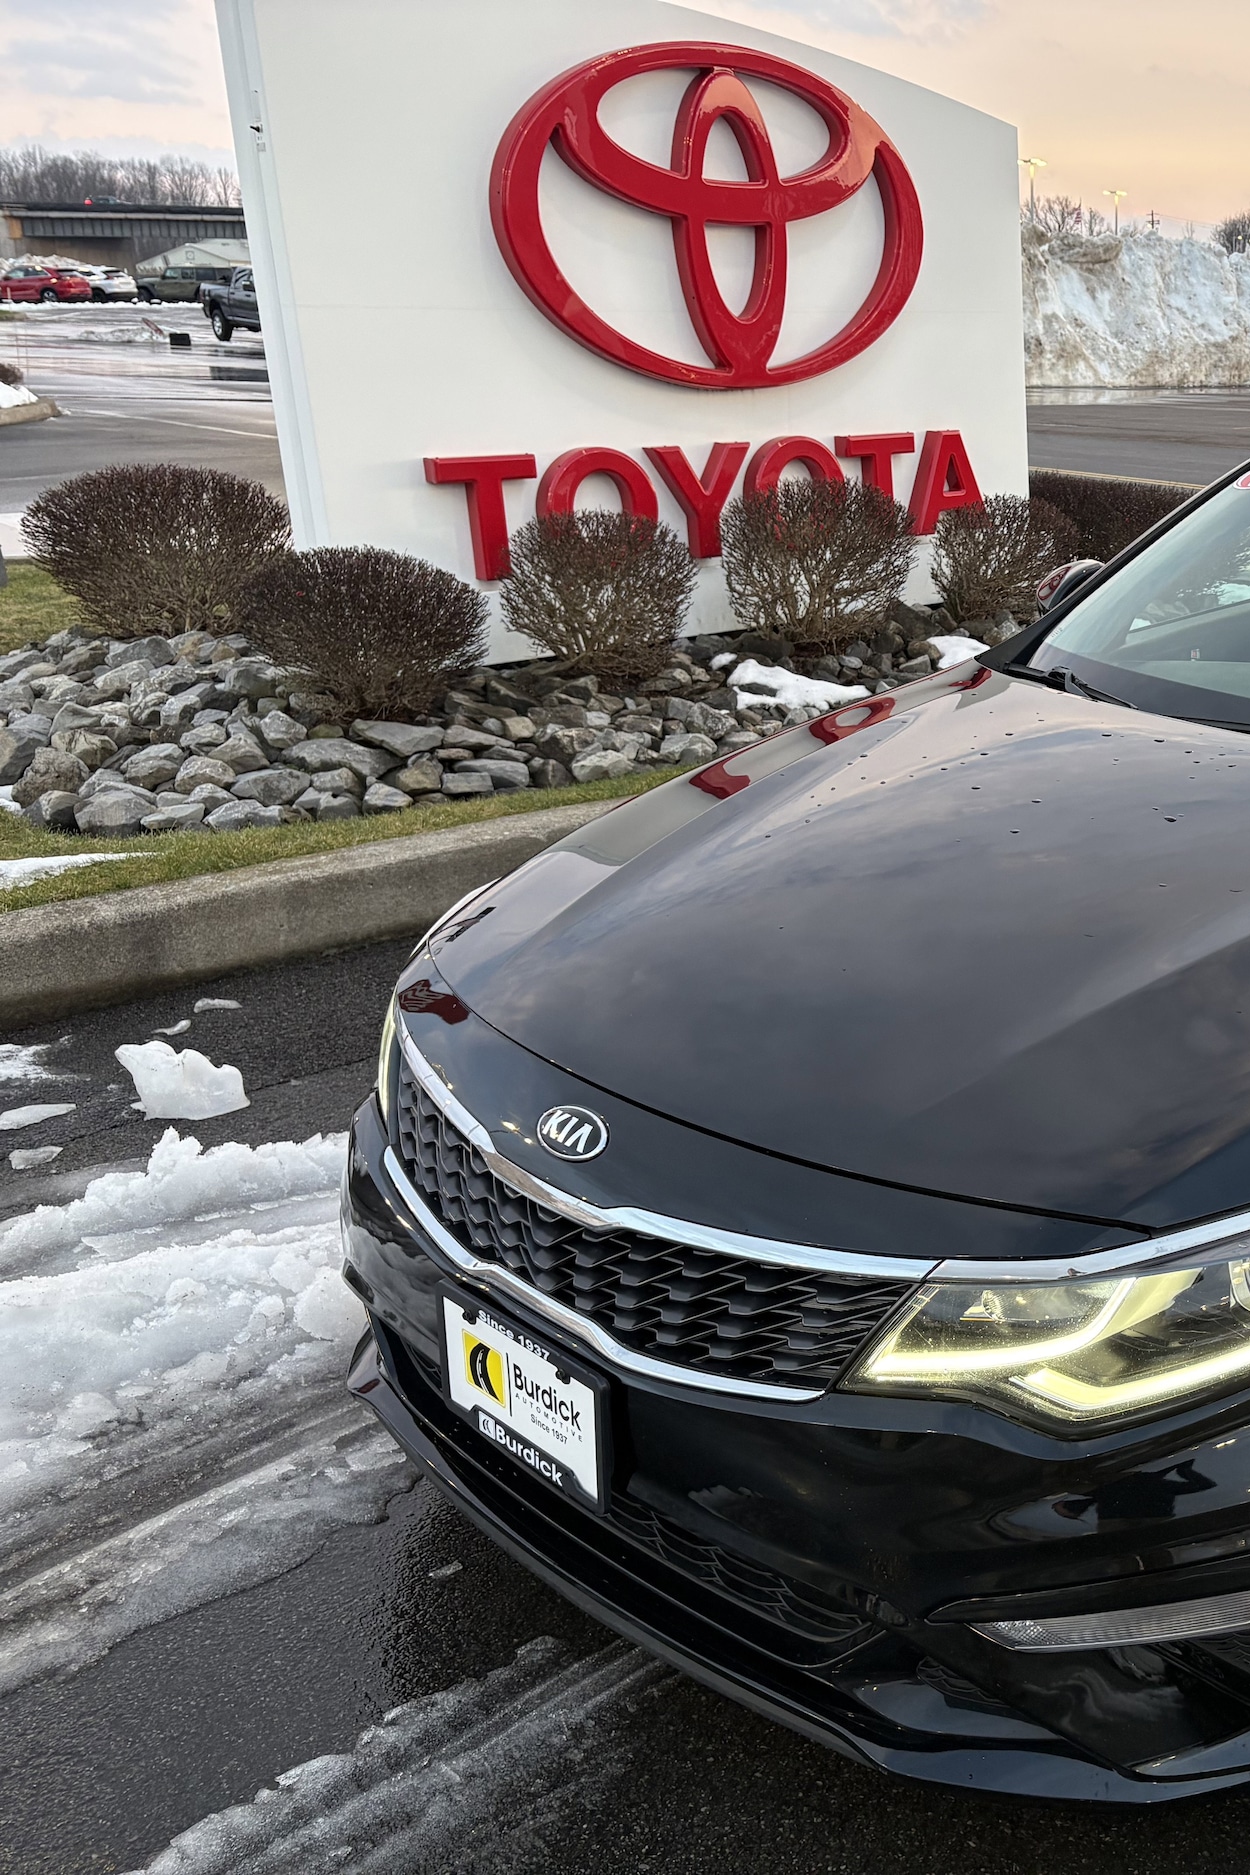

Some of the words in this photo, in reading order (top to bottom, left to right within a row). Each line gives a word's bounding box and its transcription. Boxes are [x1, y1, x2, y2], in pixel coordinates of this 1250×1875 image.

[423, 430, 987, 580] TOYOTA
[542, 1110, 594, 1154] KIA
[478, 1309, 514, 1341] Since
[517, 1334, 550, 1361] 1937
[513, 1362, 582, 1431] Burdick
[515, 1392, 583, 1443] AUTOMOTIVE
[530, 1413, 550, 1434] Since
[551, 1428, 568, 1445] 1937
[495, 1425, 563, 1487] Burdick
